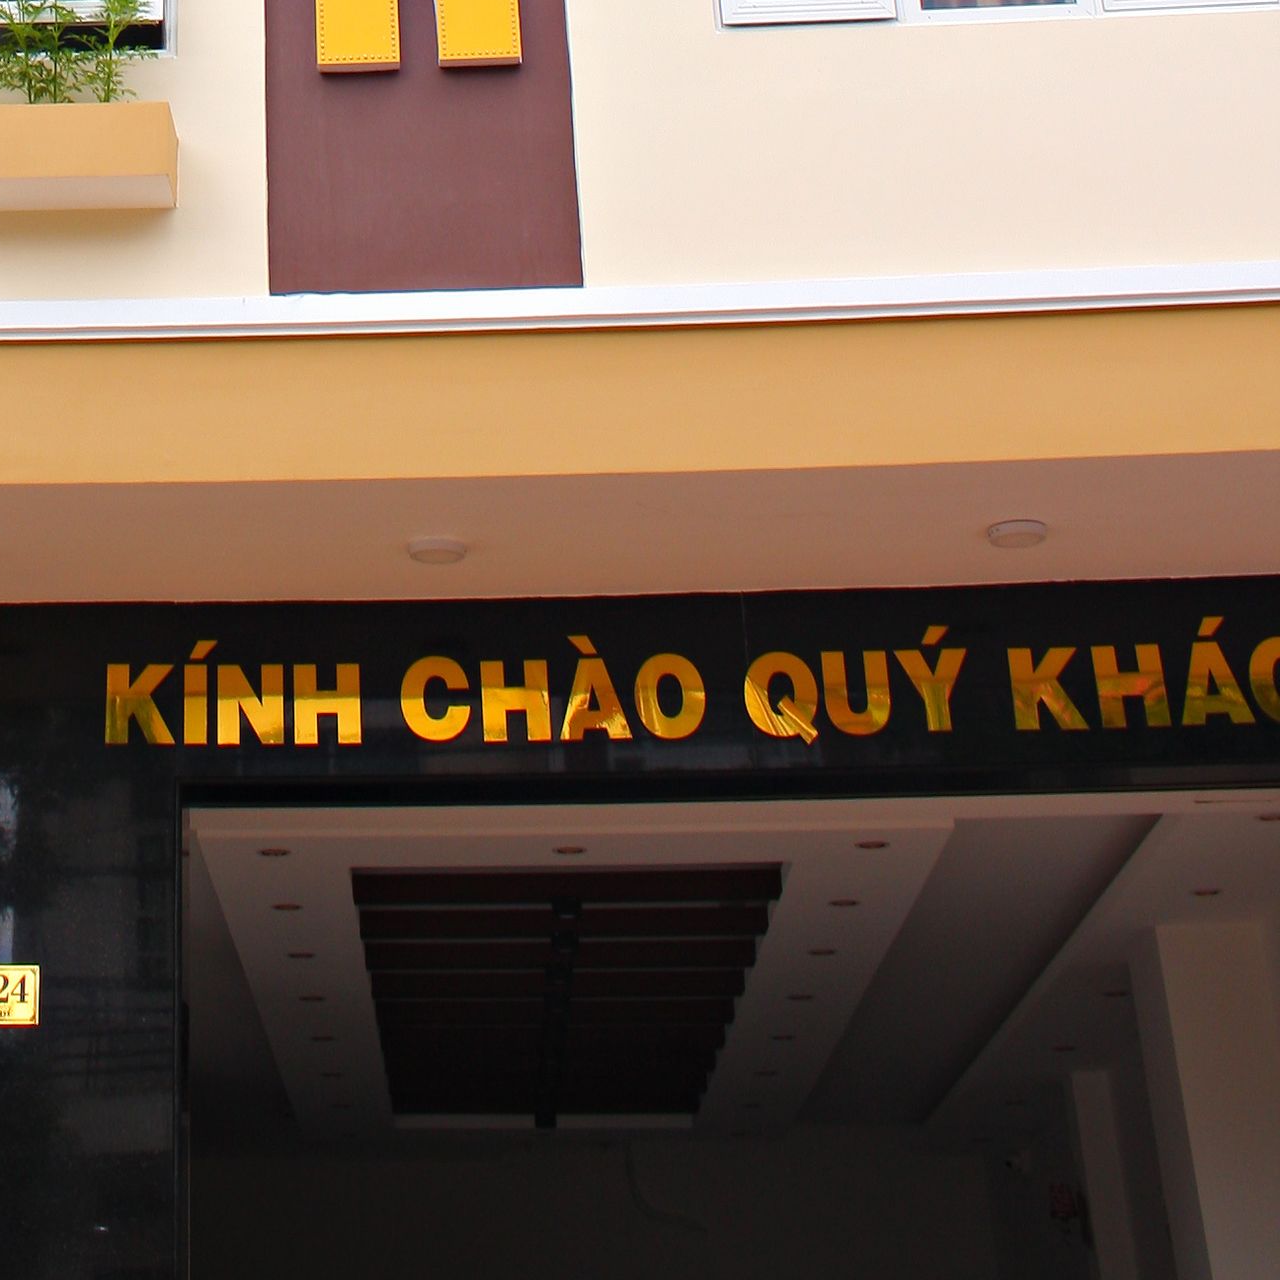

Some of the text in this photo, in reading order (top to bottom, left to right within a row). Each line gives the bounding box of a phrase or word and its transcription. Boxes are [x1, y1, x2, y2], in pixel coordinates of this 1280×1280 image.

[105, 640, 362, 745] KÍNH
[400, 635, 706, 742] CHÀO
[743, 626, 966, 745] QUÝ
